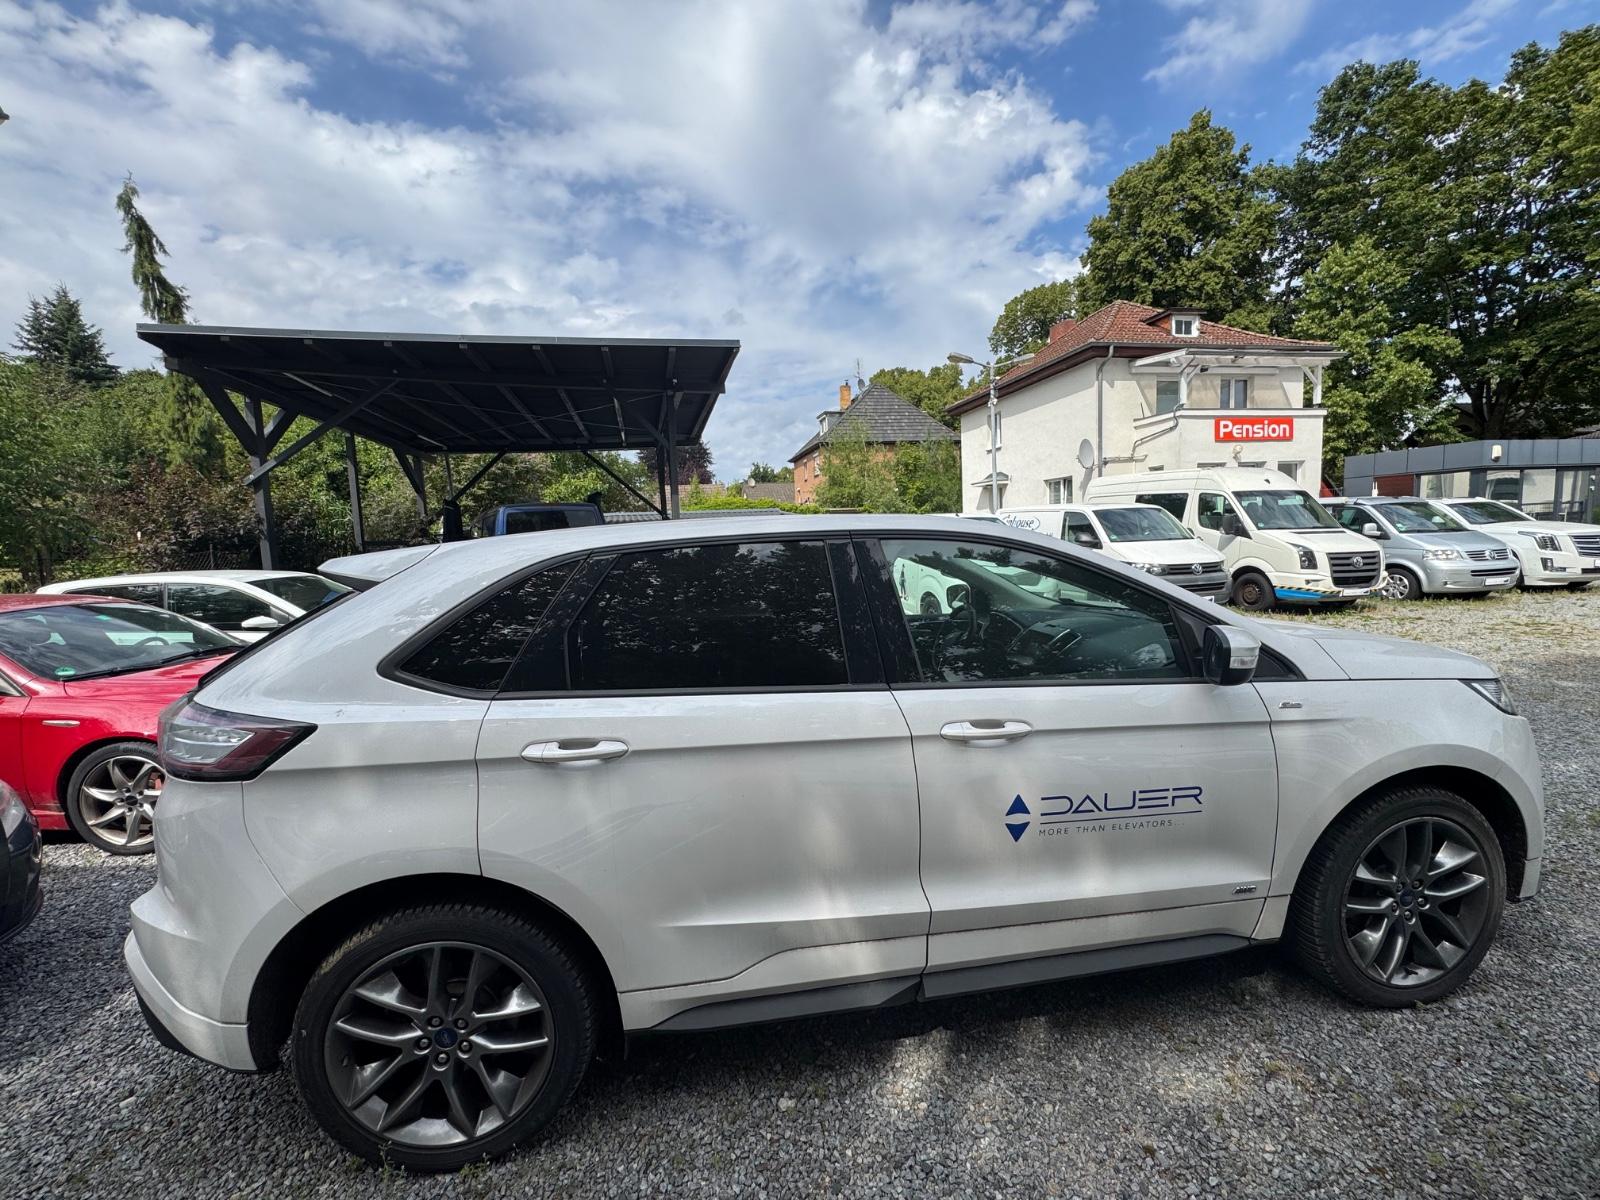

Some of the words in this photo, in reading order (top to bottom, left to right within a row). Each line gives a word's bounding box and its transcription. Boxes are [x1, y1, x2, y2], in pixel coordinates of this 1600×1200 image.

[1219, 420, 1290, 438] Pension
[1040, 786, 1203, 816] DAUER
[1039, 827, 1069, 837] MORE
[1076, 824, 1105, 833] THAN
